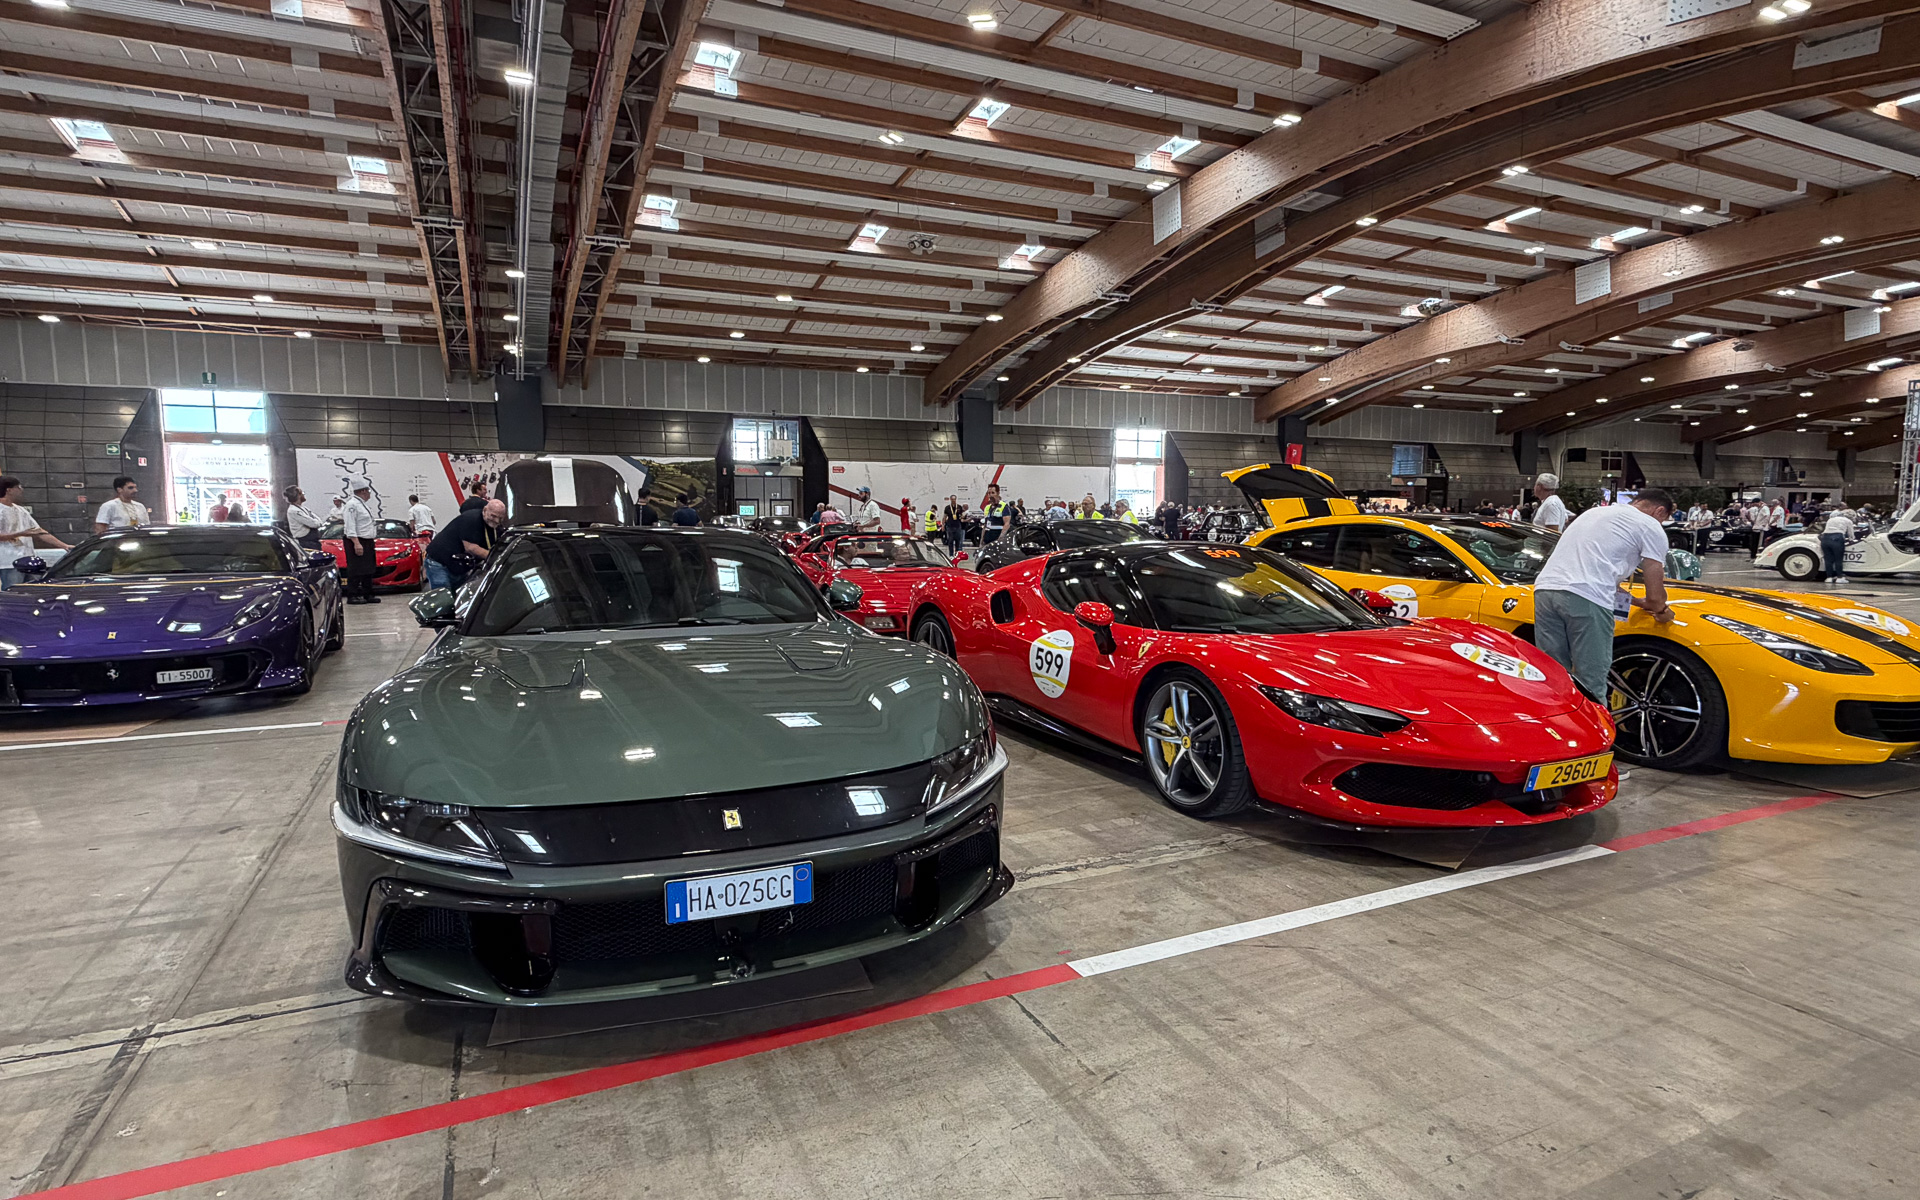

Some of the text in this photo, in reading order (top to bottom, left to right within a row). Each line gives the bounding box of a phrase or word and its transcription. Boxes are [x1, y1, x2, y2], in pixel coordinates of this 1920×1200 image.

[1203, 549, 1240, 558] 599
[1035, 646, 1064, 677] 599
[179, 669, 212, 681] 55007
[1550, 759, 1599, 785] 29601
[724, 874, 792, 907] 025CG
